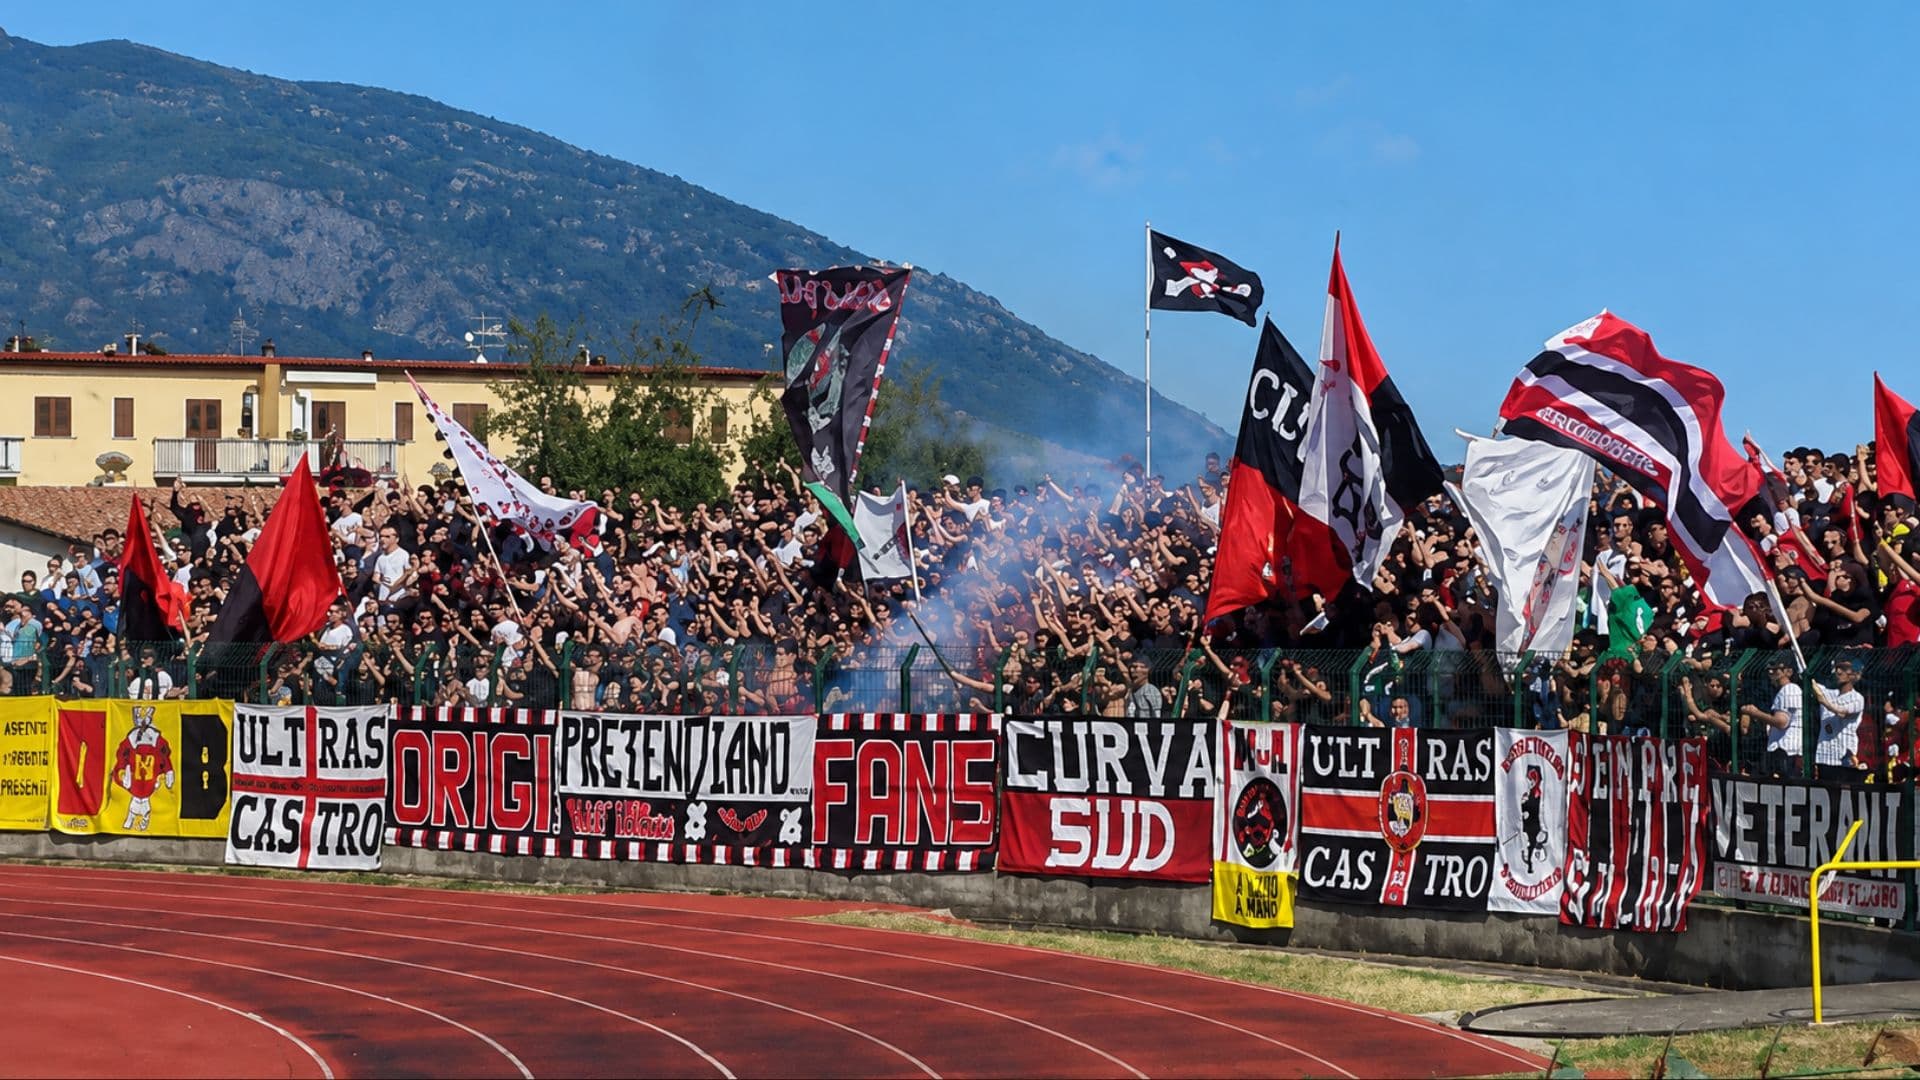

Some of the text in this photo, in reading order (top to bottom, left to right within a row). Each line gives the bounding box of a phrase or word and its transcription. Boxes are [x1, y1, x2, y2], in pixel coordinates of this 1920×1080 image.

[811, 738, 995, 845] FANS
[1005, 720, 1215, 799] CURVA
[1045, 797, 1176, 873] SUD
